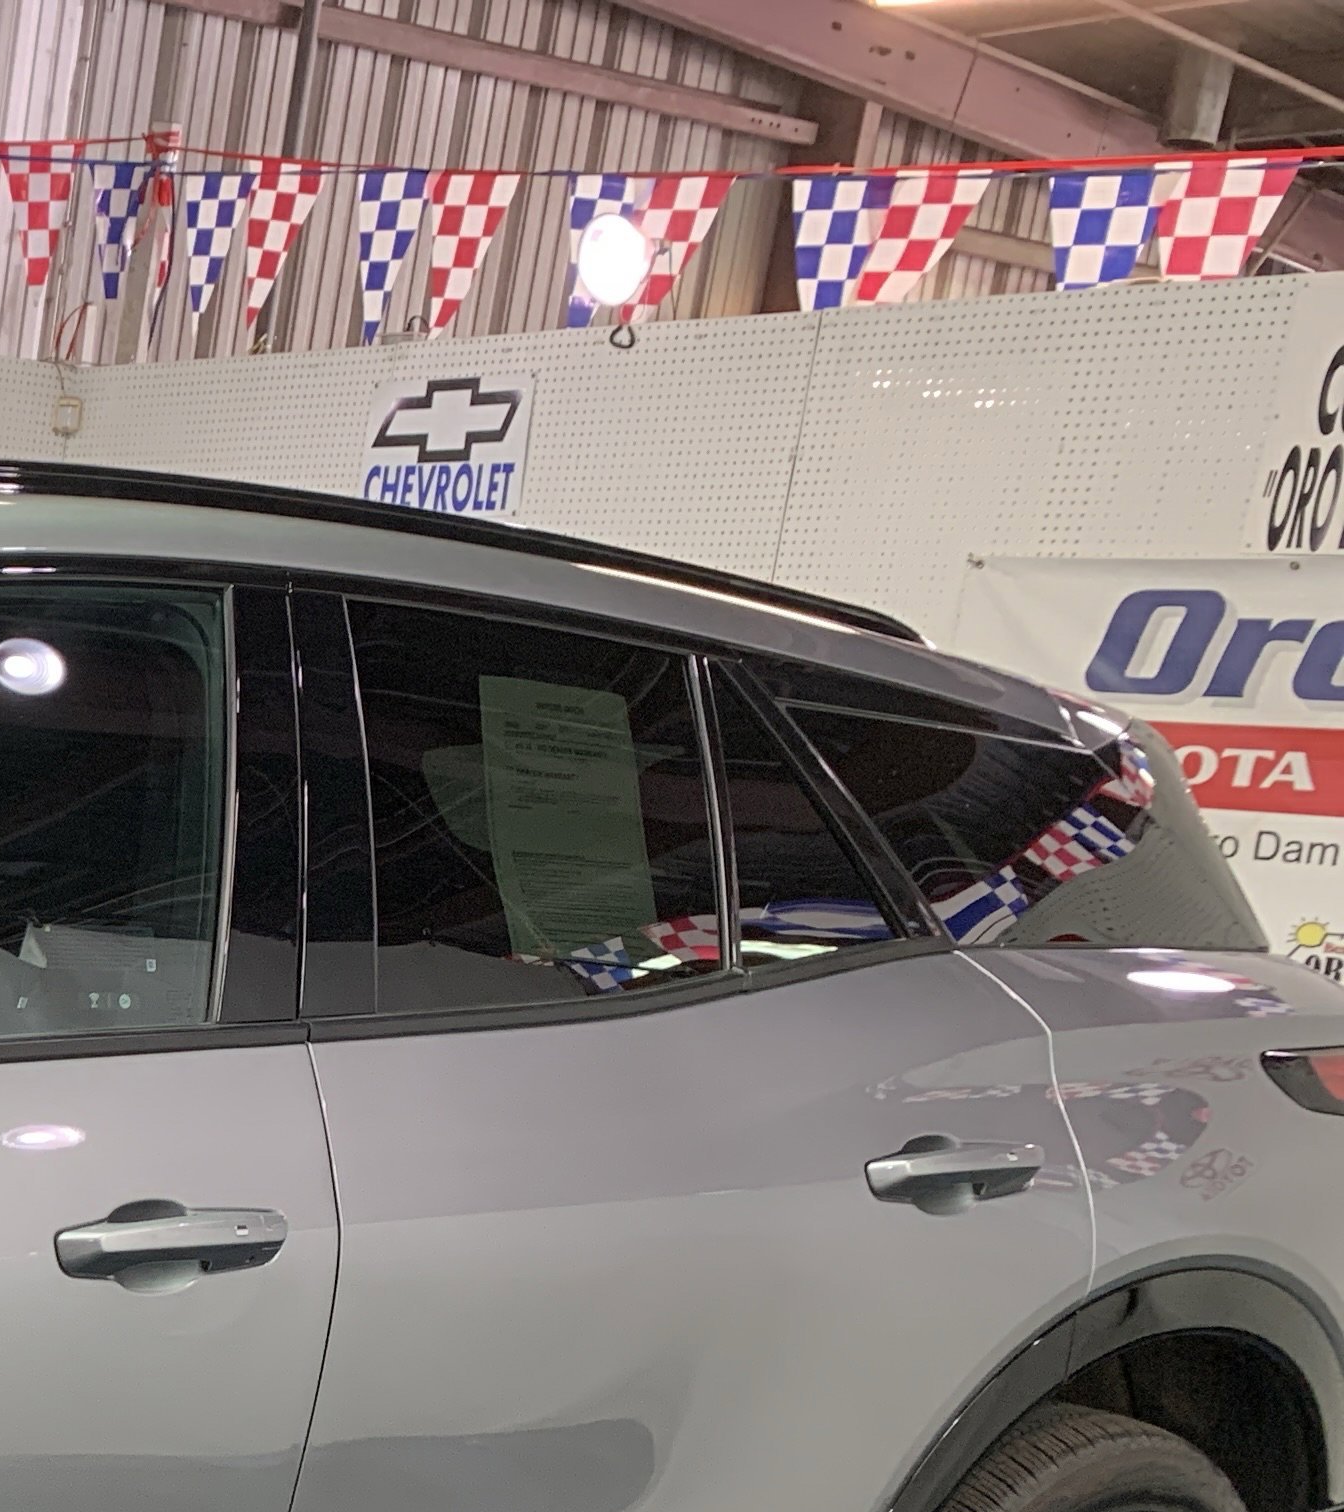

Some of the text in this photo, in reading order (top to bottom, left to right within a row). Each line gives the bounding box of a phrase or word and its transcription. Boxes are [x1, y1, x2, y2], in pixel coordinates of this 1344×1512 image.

[364, 462, 516, 512] CHEVROLET
[1174, 744, 1316, 792] OTA
[1253, 830, 1340, 867] Dam
